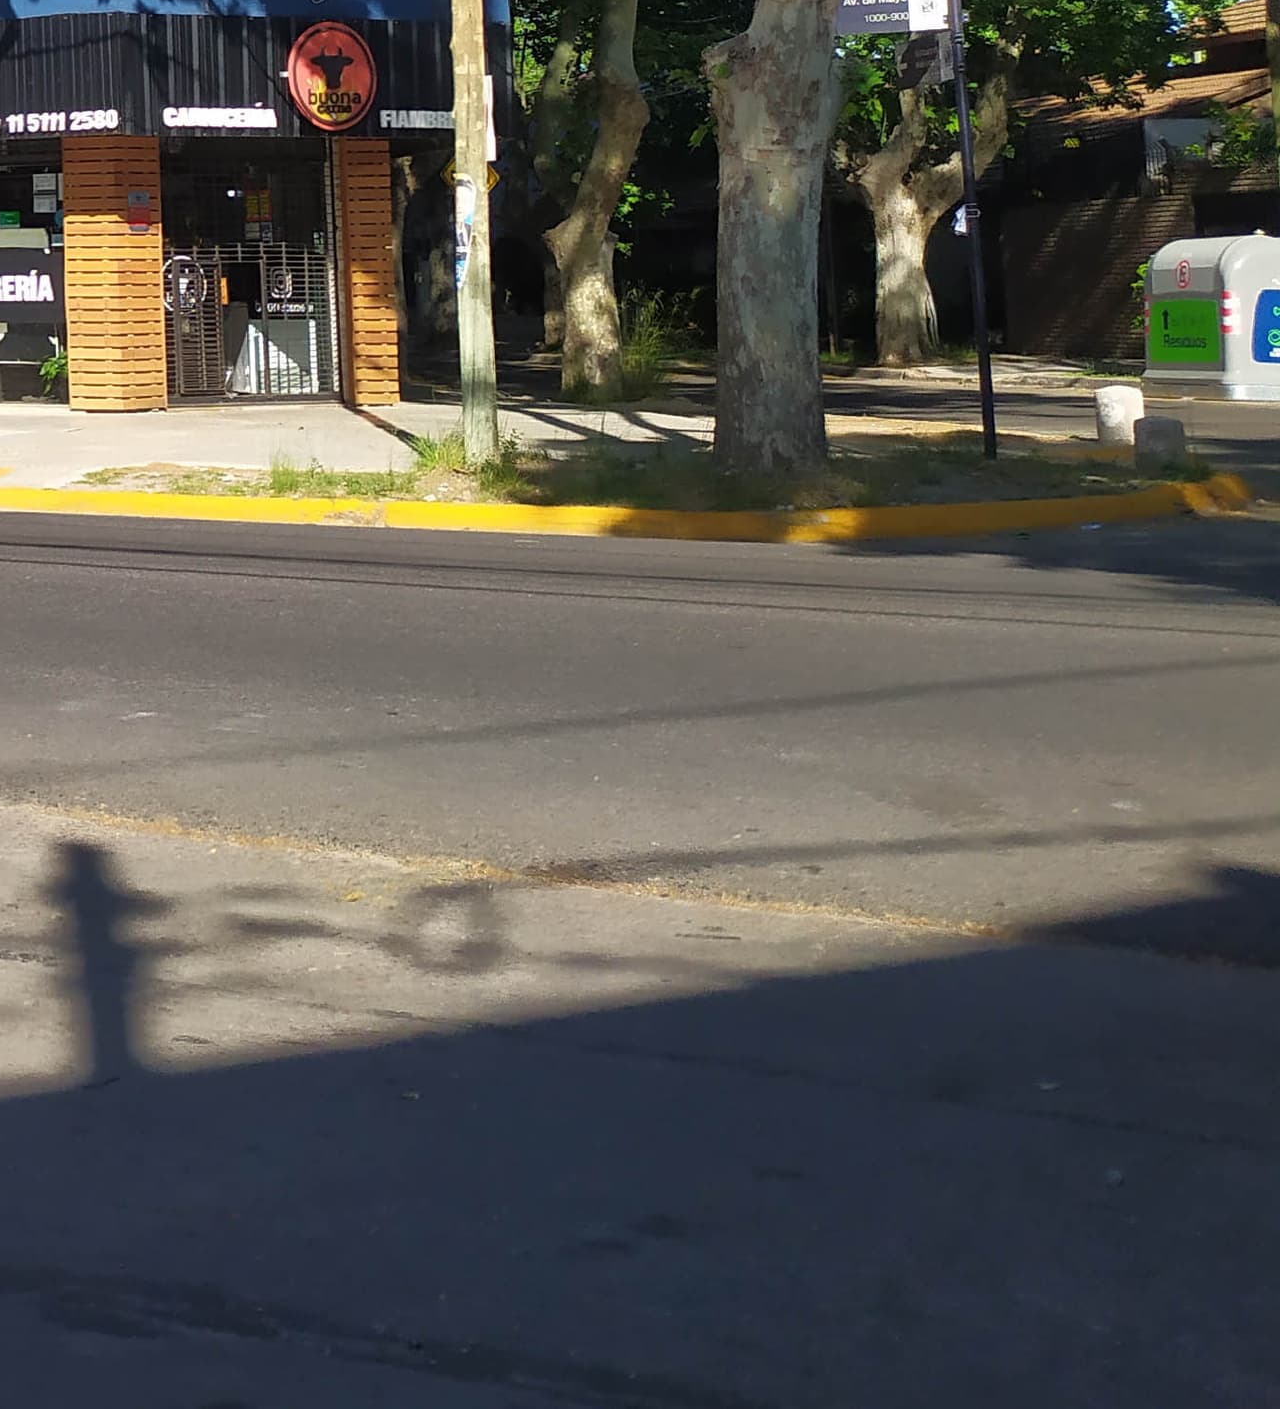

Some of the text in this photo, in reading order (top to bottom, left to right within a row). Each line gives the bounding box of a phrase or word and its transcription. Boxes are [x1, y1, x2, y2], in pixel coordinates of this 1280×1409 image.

[864, 12, 909, 23] 1000-900
[308, 89, 362, 106] buona
[6, 114, 24, 133] 11
[26, 112, 66, 132] 5111
[70, 109, 118, 131] 2580
